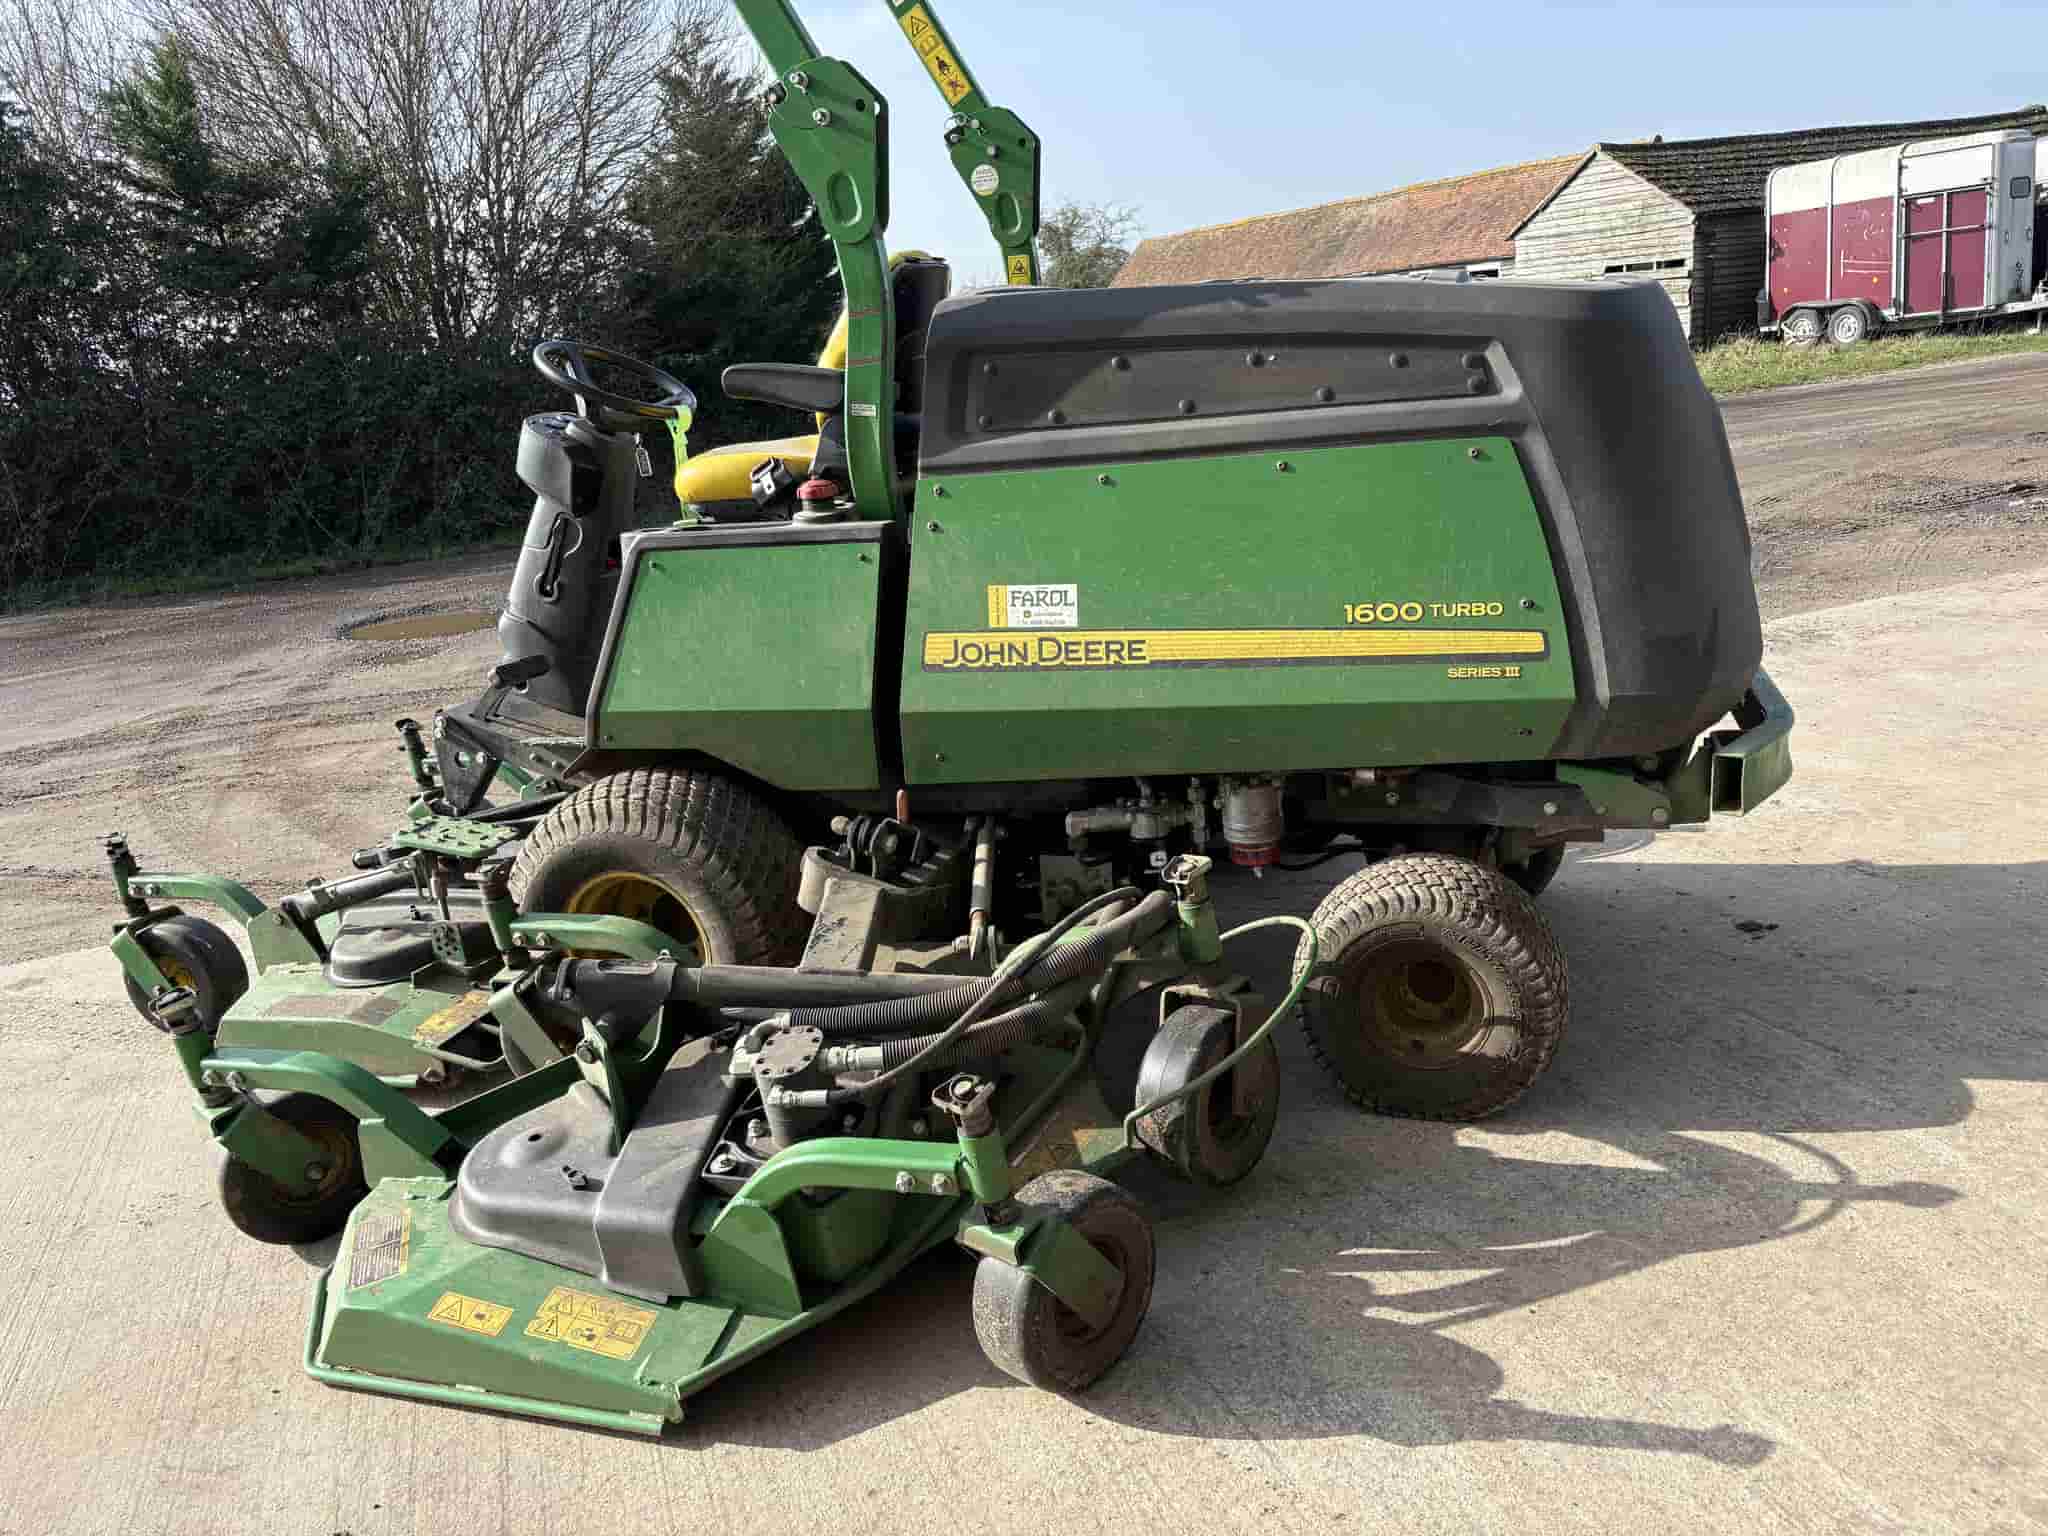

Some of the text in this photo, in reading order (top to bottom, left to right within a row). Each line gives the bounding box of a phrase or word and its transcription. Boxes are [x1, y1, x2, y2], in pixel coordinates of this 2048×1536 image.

[1009, 590, 1075, 607] FAROL
[1344, 602, 1504, 623] 1600 TURBO
[943, 637, 1147, 665] JOHN DEERE
[1447, 666, 1520, 679] SERIES III
